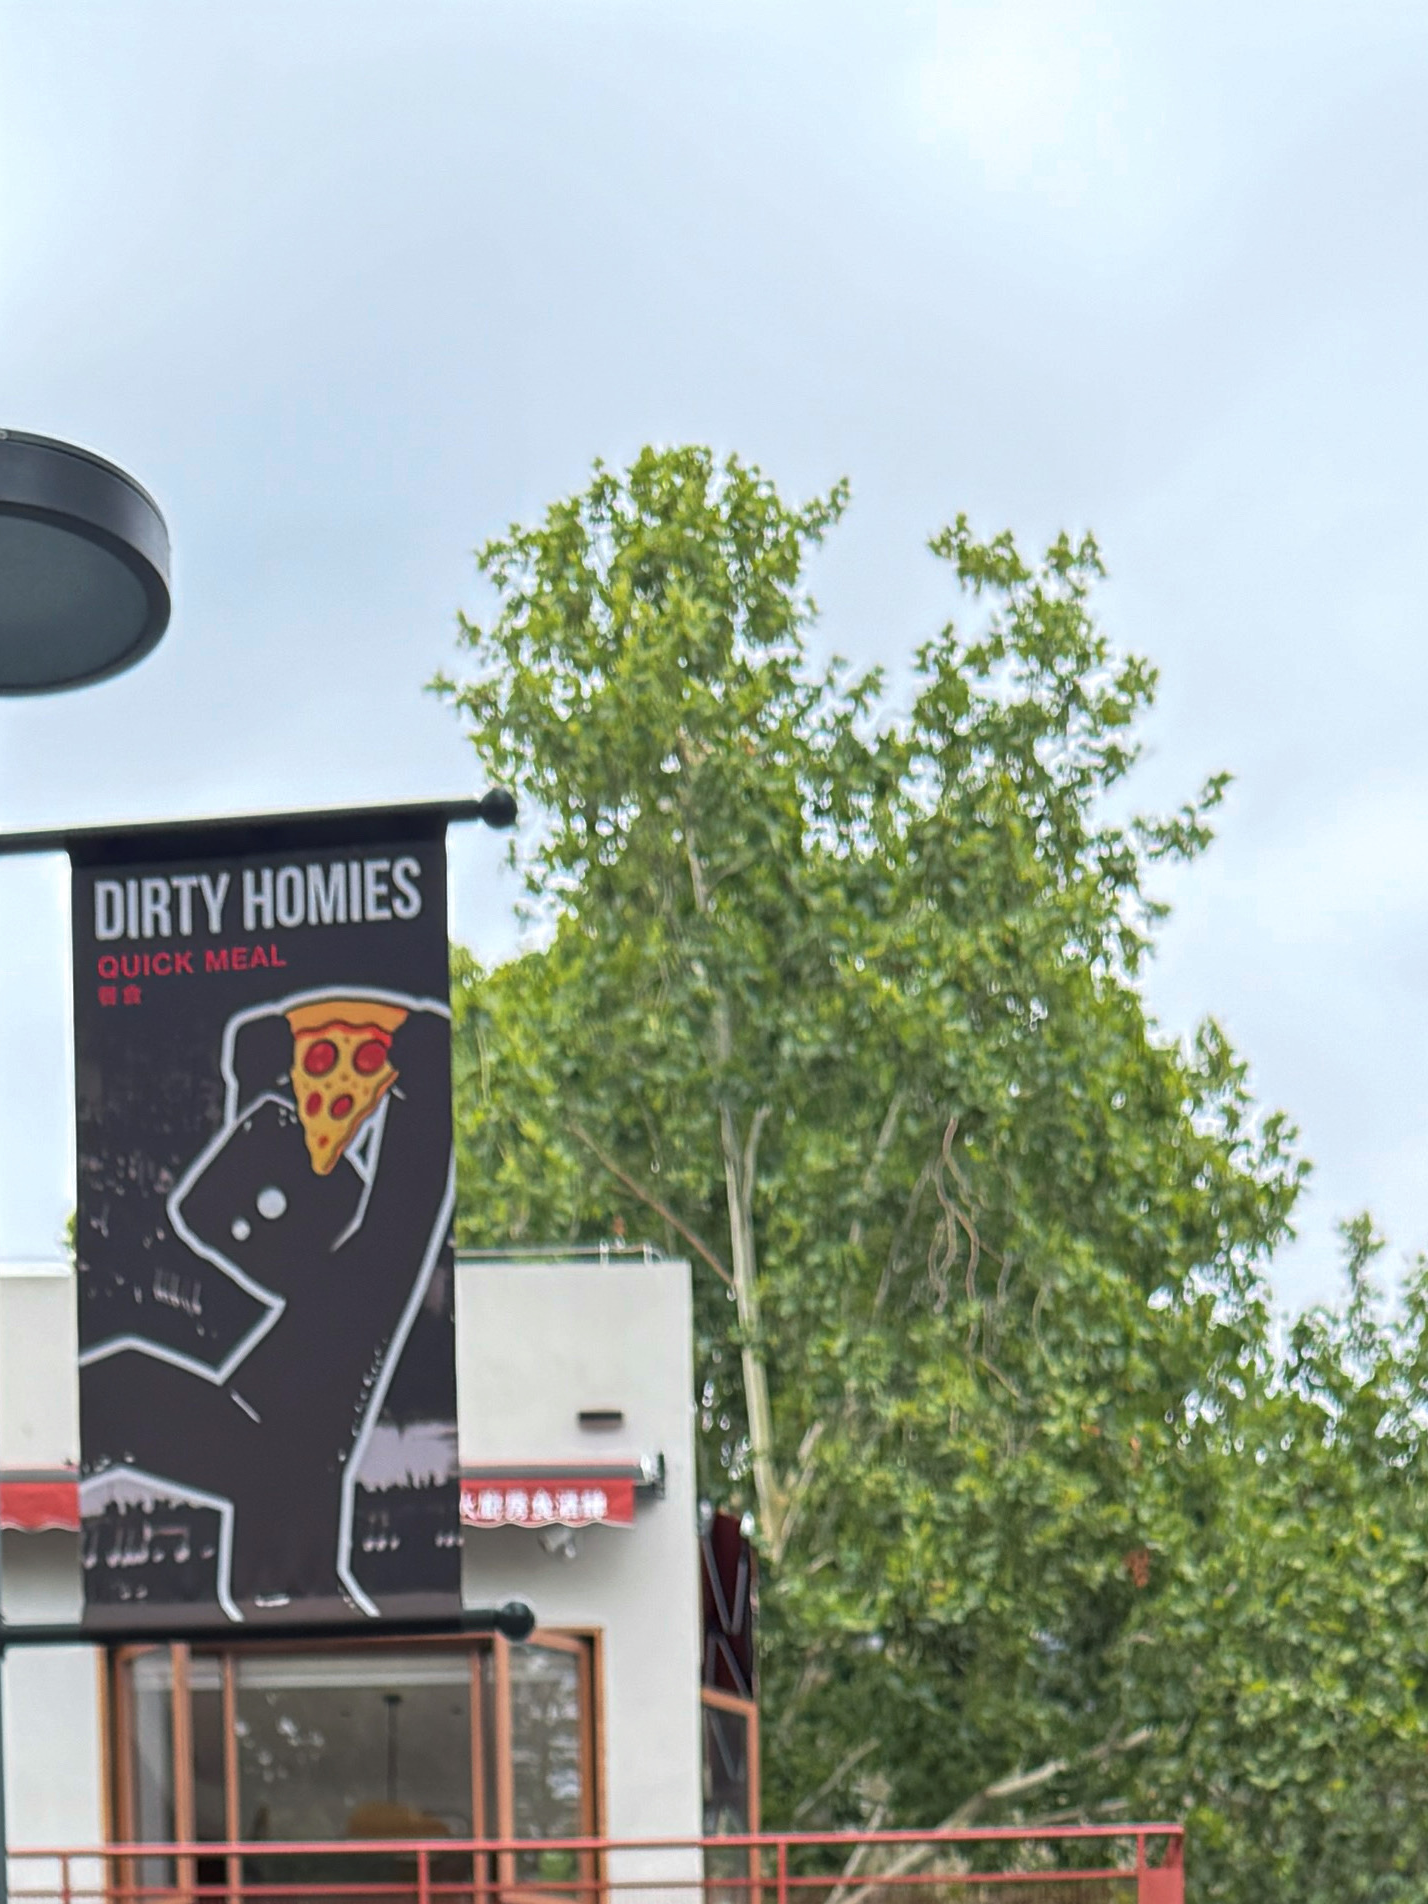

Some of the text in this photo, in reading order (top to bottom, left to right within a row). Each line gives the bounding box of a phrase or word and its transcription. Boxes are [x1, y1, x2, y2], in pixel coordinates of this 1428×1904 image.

[94, 856, 422, 941] DIRTY HOMIES
[97, 943, 287, 980] QUICK MEAL
